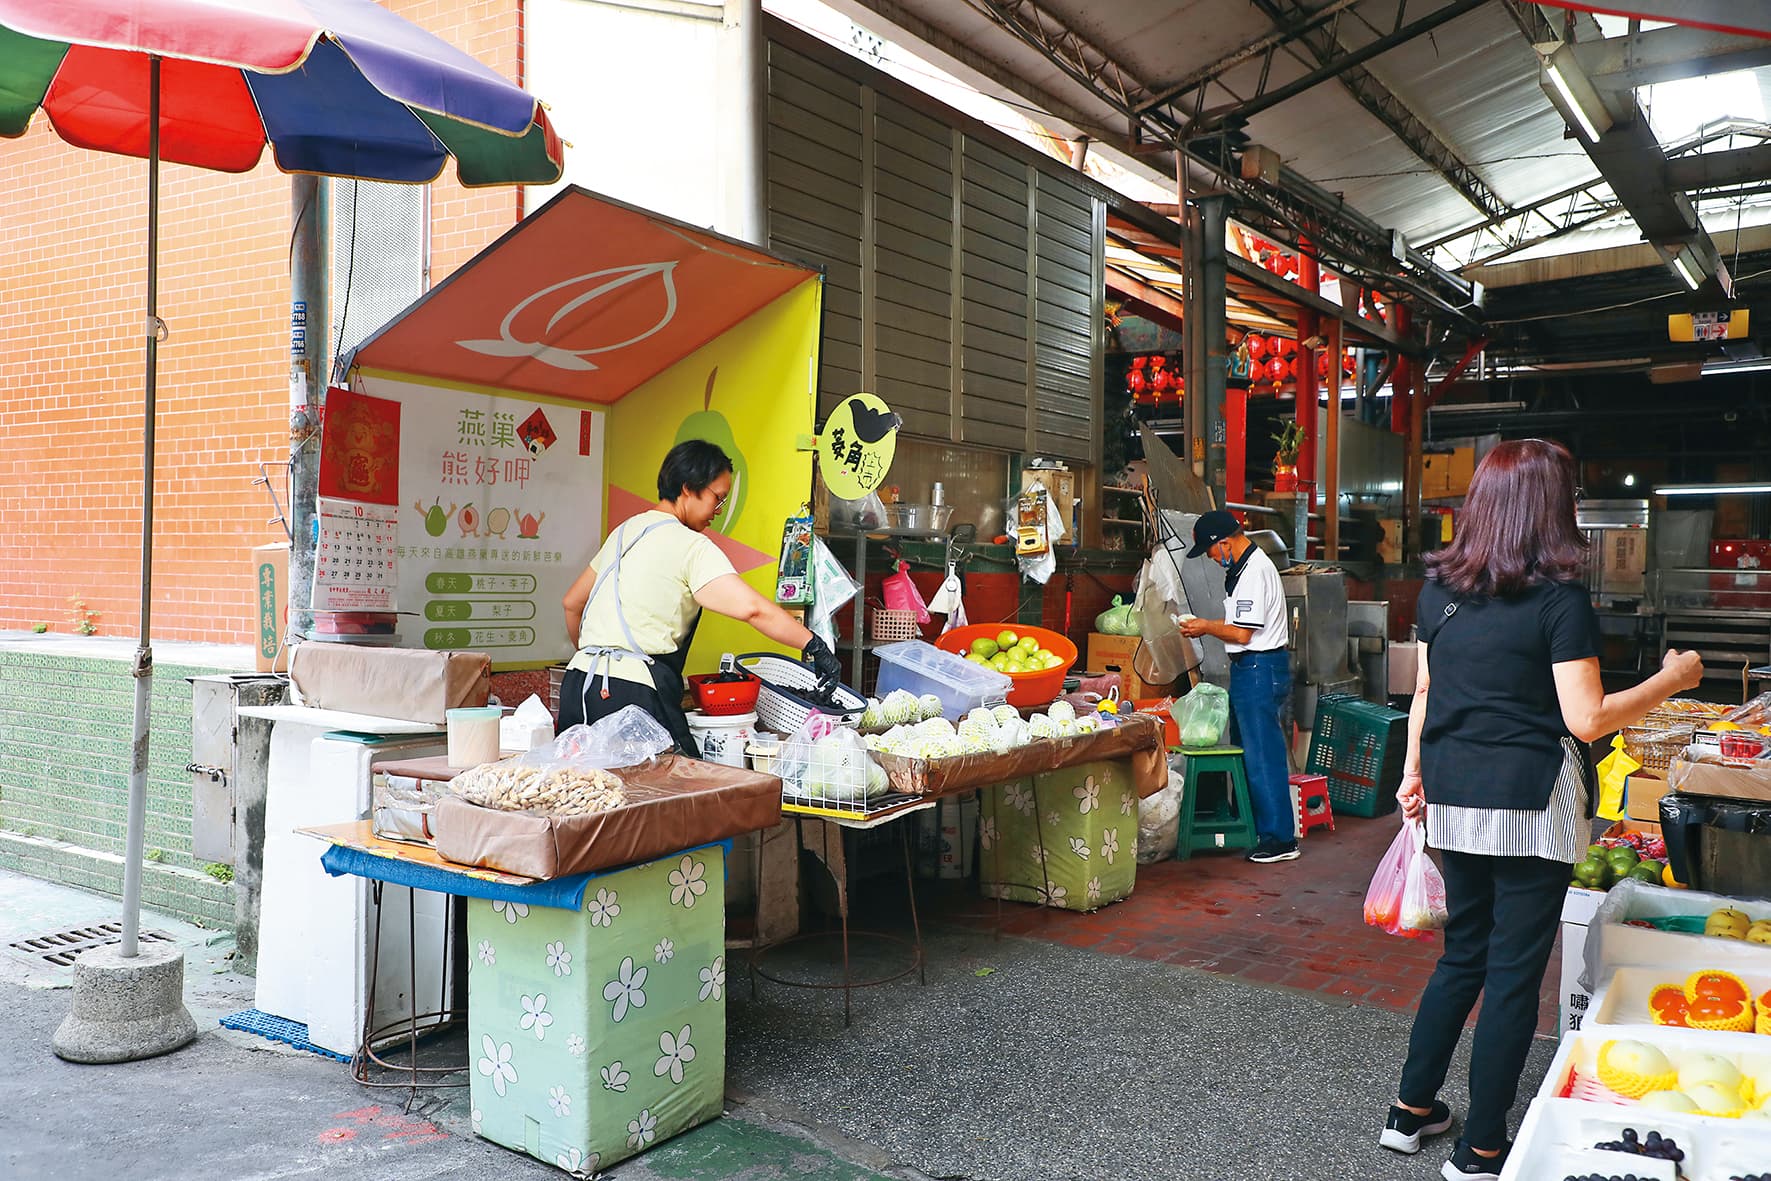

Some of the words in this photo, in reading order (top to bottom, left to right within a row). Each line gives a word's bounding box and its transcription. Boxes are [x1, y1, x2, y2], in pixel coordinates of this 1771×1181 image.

[458, 409, 515, 448] 燕巢
[832, 427, 863, 472] 菱角
[441, 450, 530, 490] 熊好呷
[354, 506, 363, 517] 10
[436, 577, 457, 590] 春天
[261, 566, 276, 654] 專業栽培
[434, 605, 456, 617] 夏天
[434, 632, 456, 644] 秋冬
